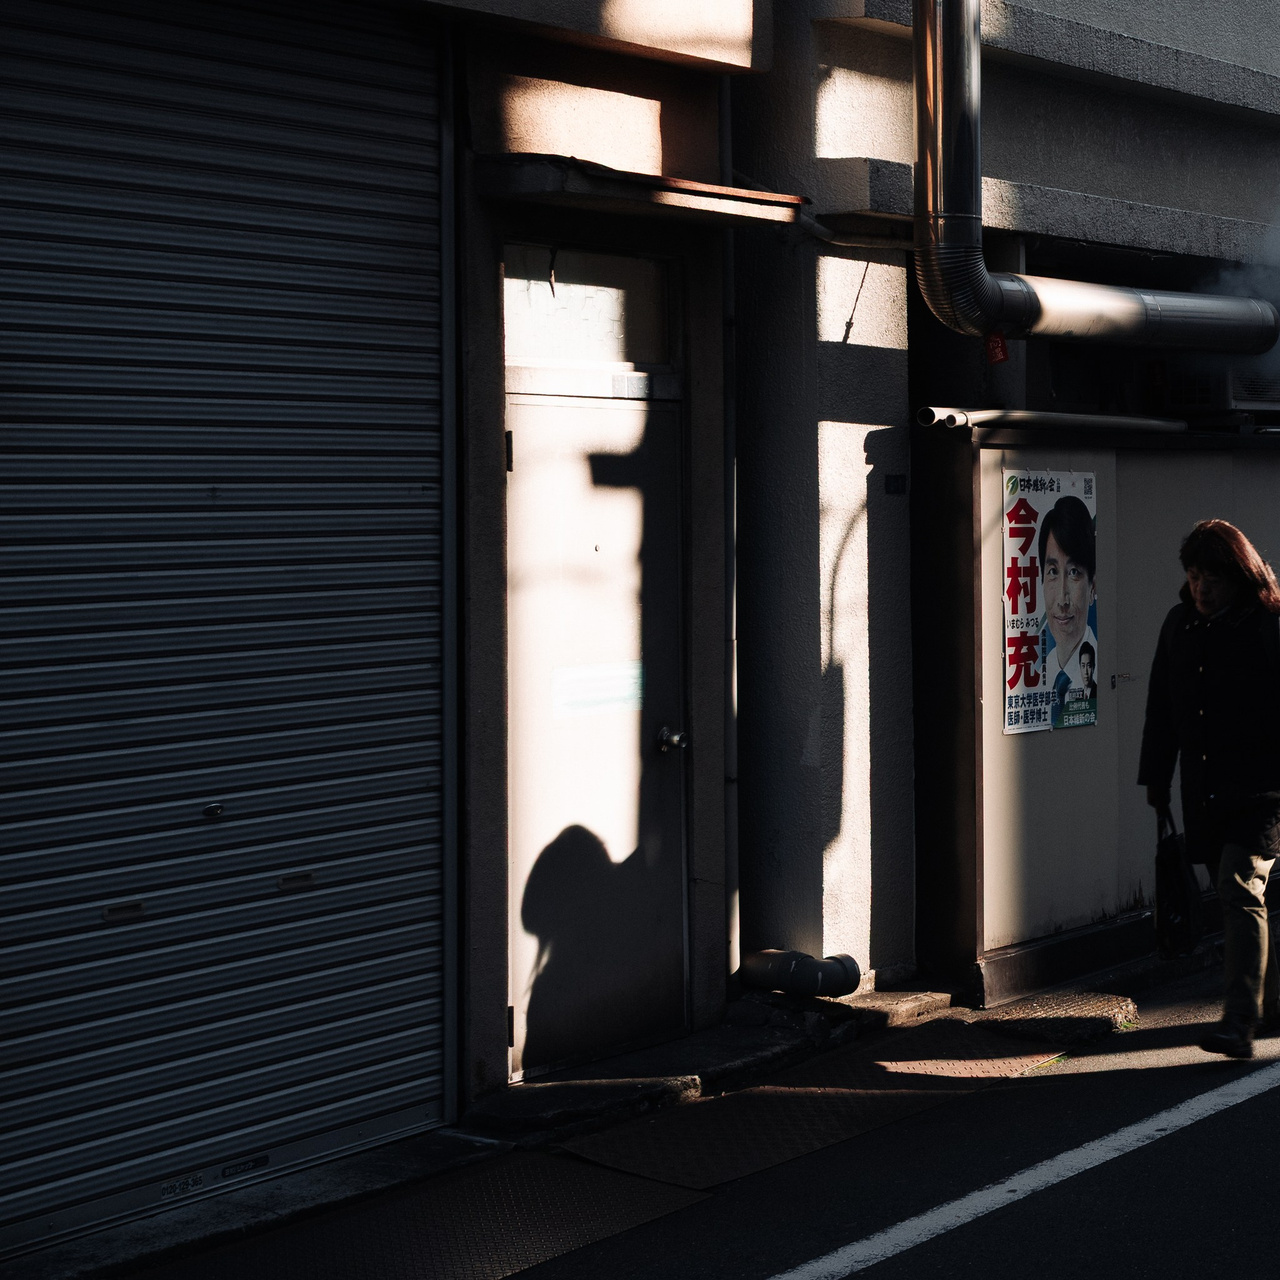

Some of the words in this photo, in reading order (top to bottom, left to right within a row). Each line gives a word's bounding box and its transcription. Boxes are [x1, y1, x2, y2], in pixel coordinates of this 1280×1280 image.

[1019, 476, 1056, 495] 日本維新の会
